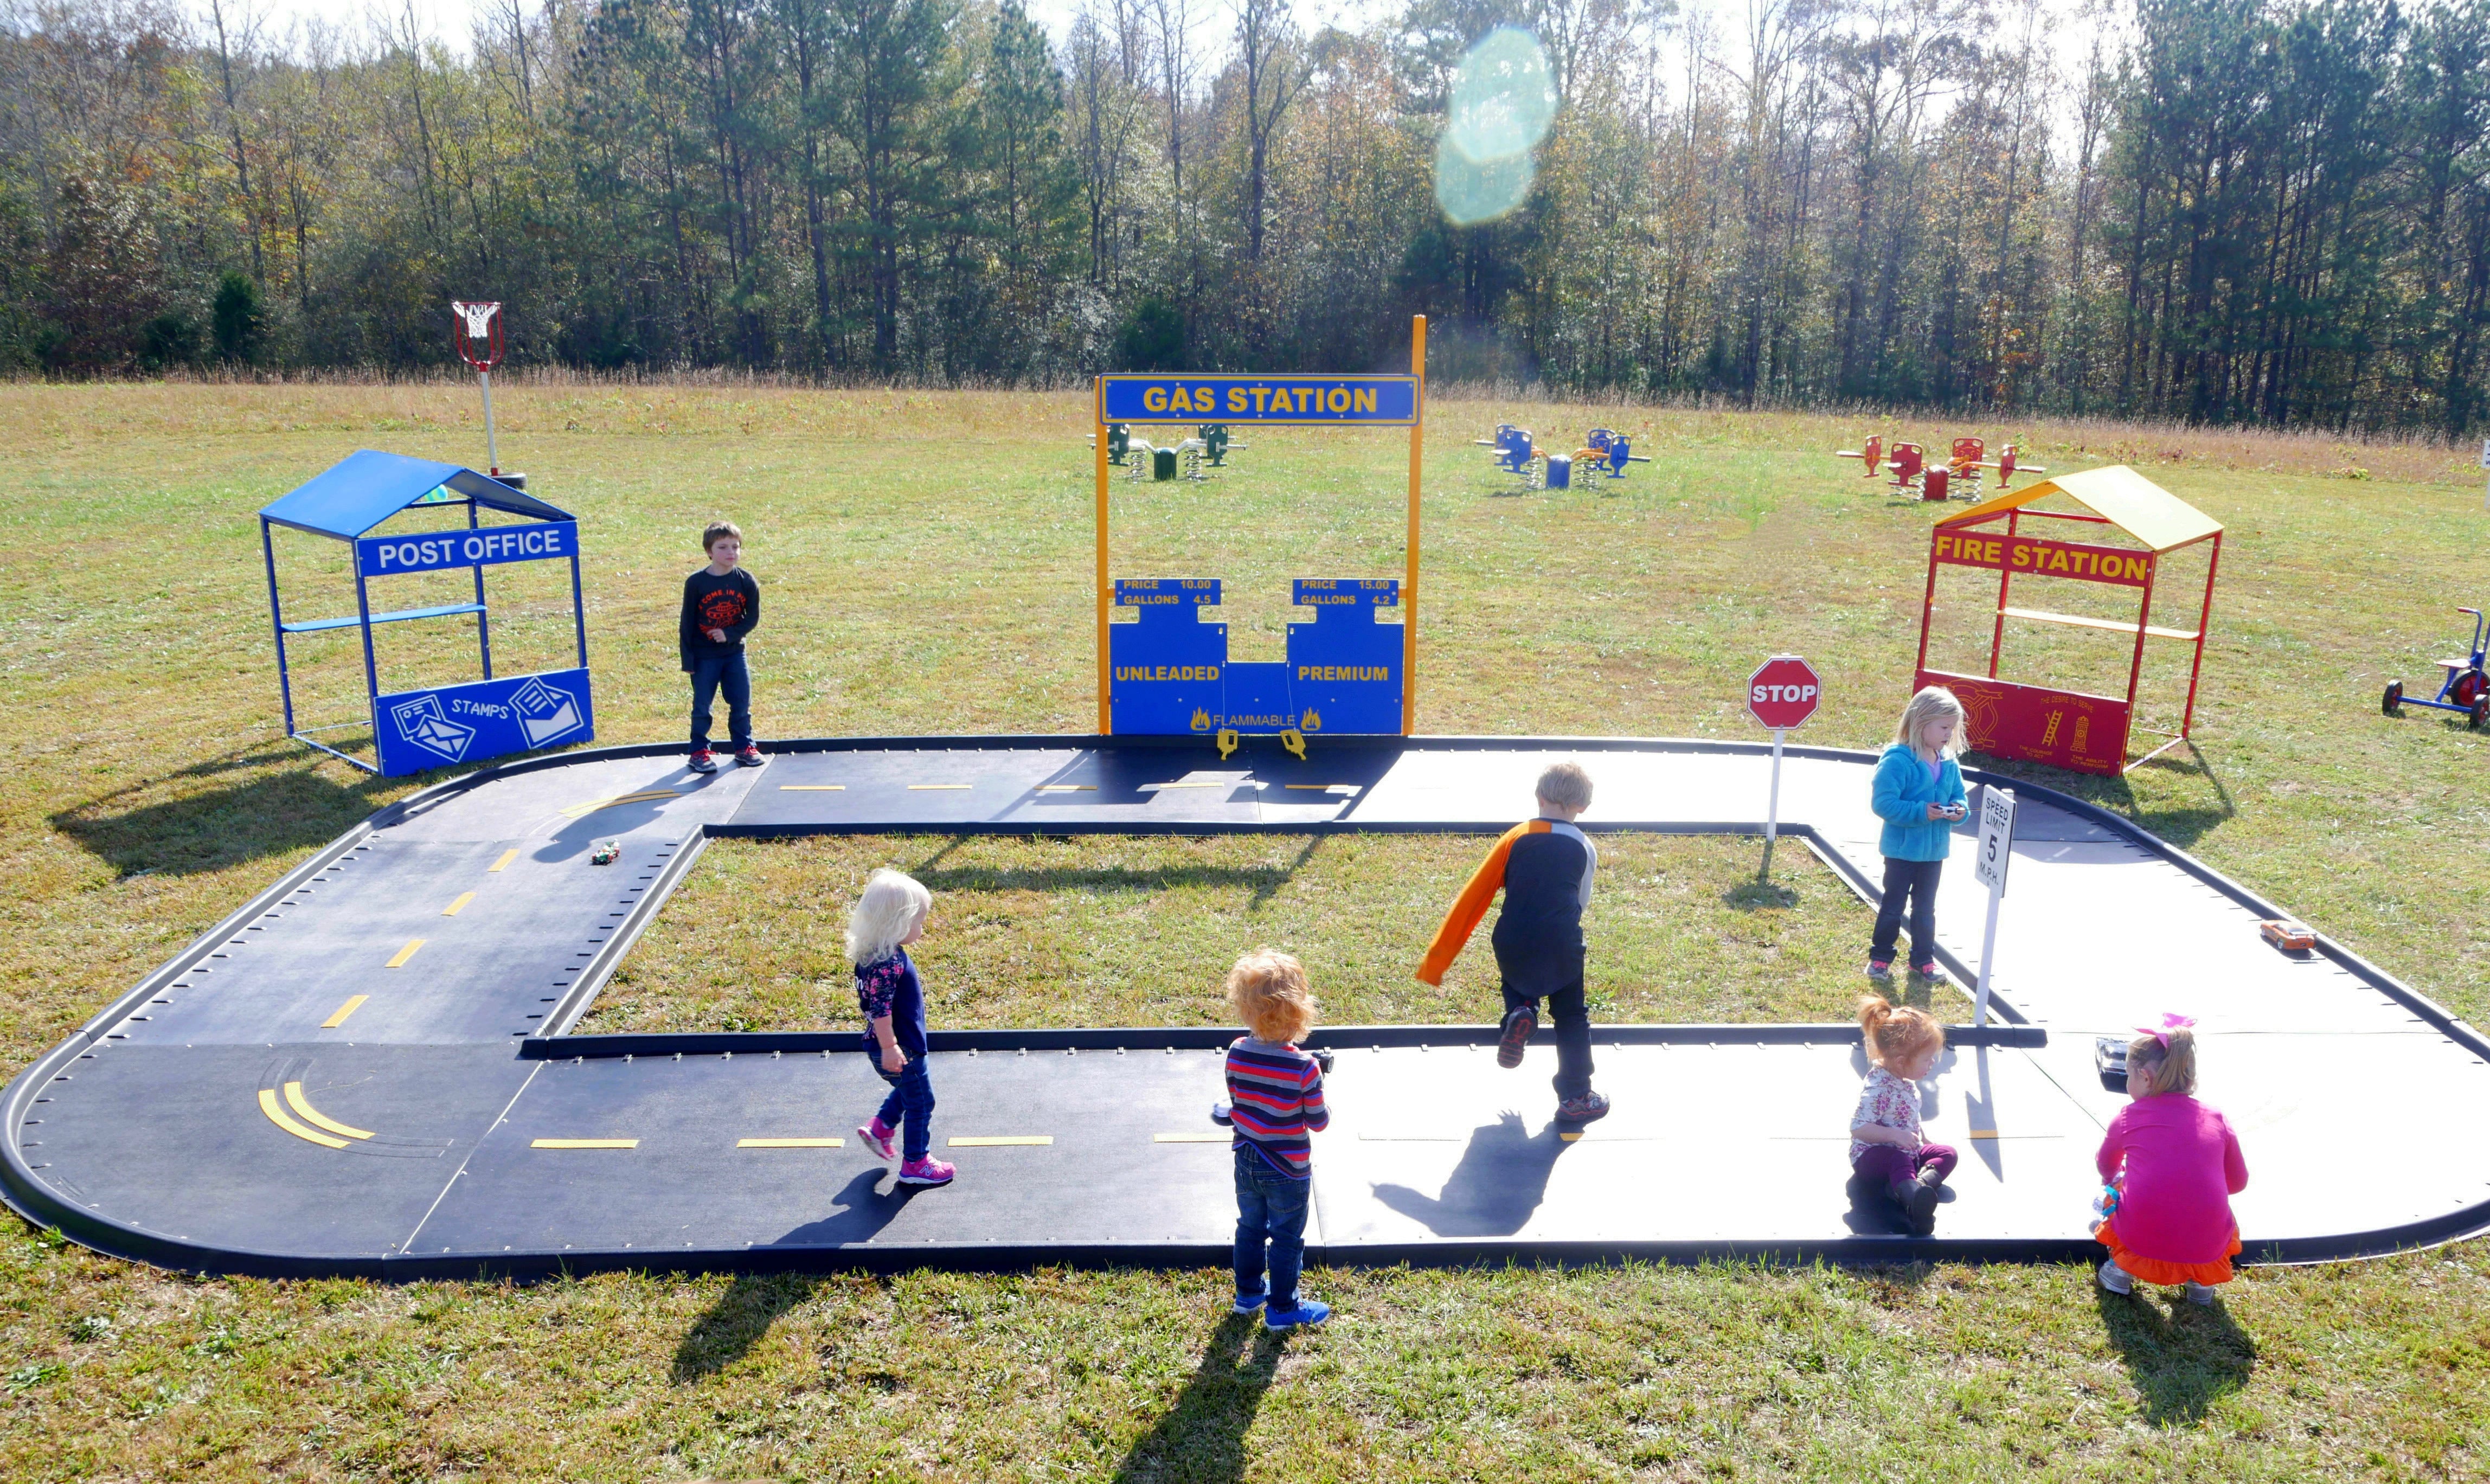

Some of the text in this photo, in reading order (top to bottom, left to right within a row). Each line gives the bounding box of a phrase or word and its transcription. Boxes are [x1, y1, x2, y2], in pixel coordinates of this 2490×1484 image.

[1144, 387, 1377, 413] GAS STATION
[380, 530, 561, 568] POST OFFICE
[1935, 536, 2147, 581] FIRE STATION
[1124, 580, 1211, 589] PRICE 10.00
[1302, 580, 1389, 589] PRICE 15.00
[702, 589, 722, 603] COME
[1124, 595, 1211, 604] GALLONS 4.5
[1301, 595, 1389, 605] GALLONS 4.2
[1116, 666, 1219, 681] UNLEADED
[1298, 666, 1388, 681] PREMIUM
[1753, 684, 1817, 703] STOP
[452, 699, 509, 720] STAMPS
[2071, 697, 2077, 705] TO
[2078, 699, 2094, 713] SERVE
[1213, 715, 1295, 726] FLAMMABLE
[1986, 798, 2008, 821] SPEED
[1986, 812, 2005, 834] LIMIT
[1987, 834, 1998, 863] 5
[1979, 862, 1999, 885] M.P.H.
[920, 1165, 934, 1176] N
